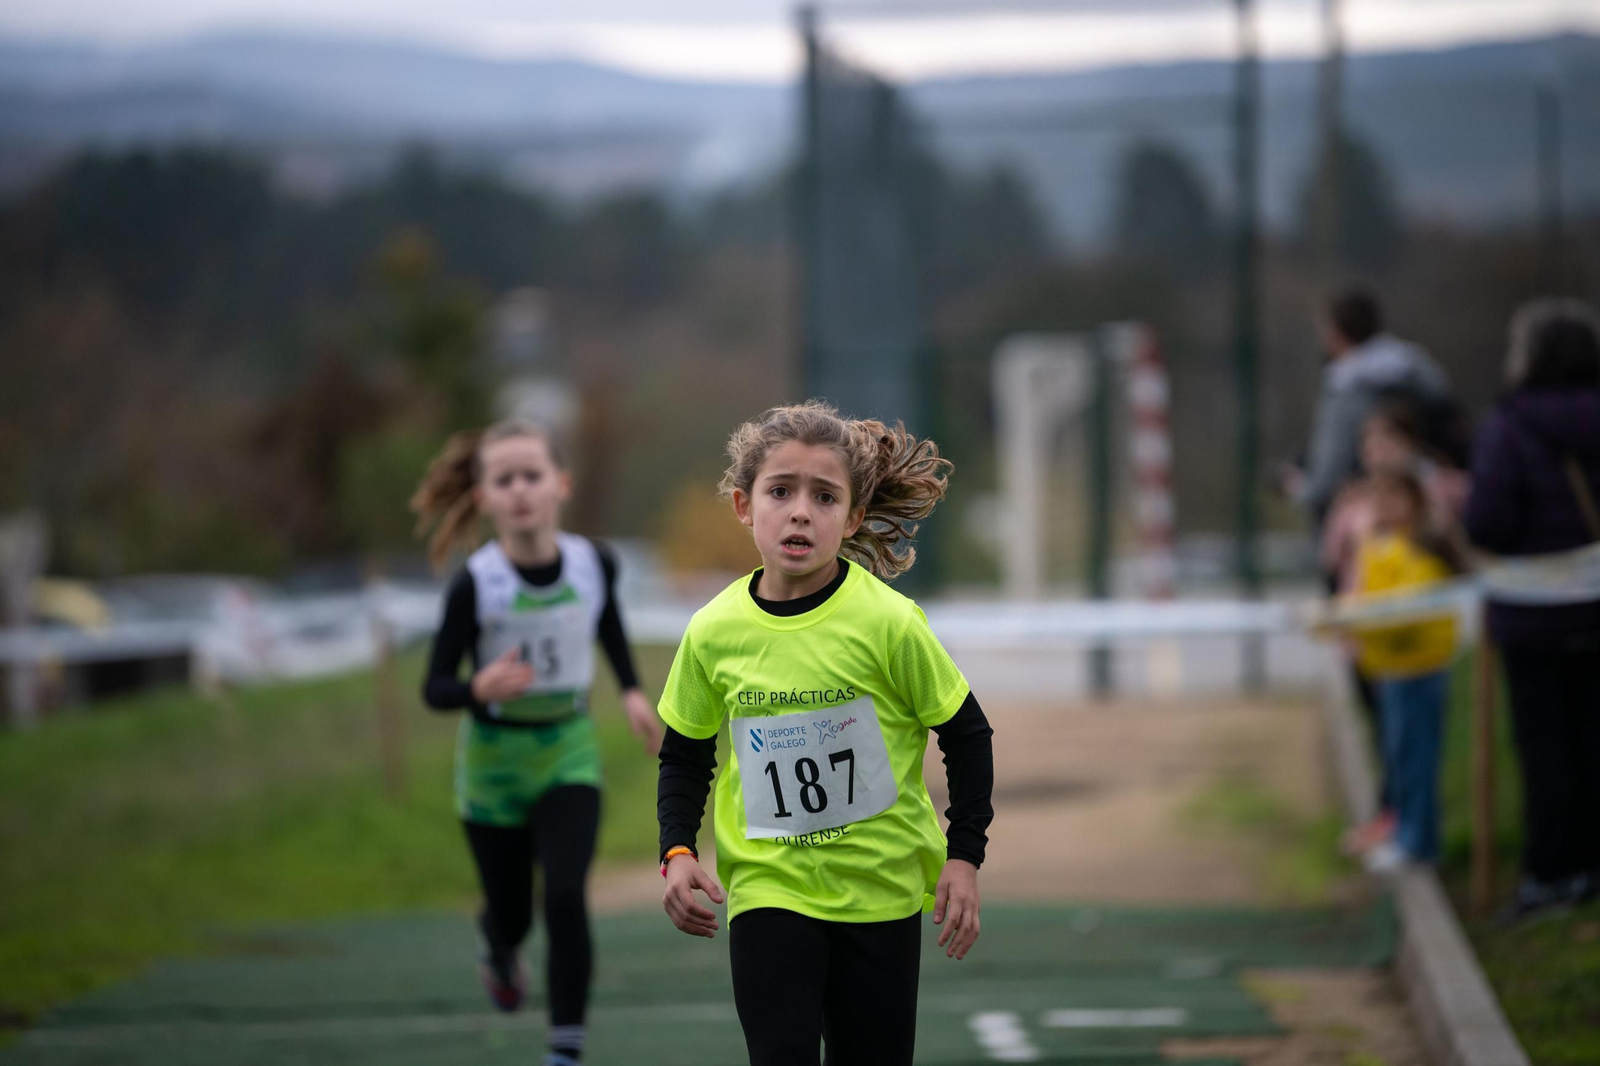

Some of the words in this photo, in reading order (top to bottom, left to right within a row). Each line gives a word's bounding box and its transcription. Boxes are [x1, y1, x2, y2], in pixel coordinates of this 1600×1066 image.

[738, 691, 765, 705] CEIP
[770, 686, 856, 705] PRÁCTICAS
[767, 726, 807, 739] DEPORTE
[770, 738, 806, 750] GALEGO
[764, 748, 855, 818] 187
[775, 825, 850, 847] OURENSE
